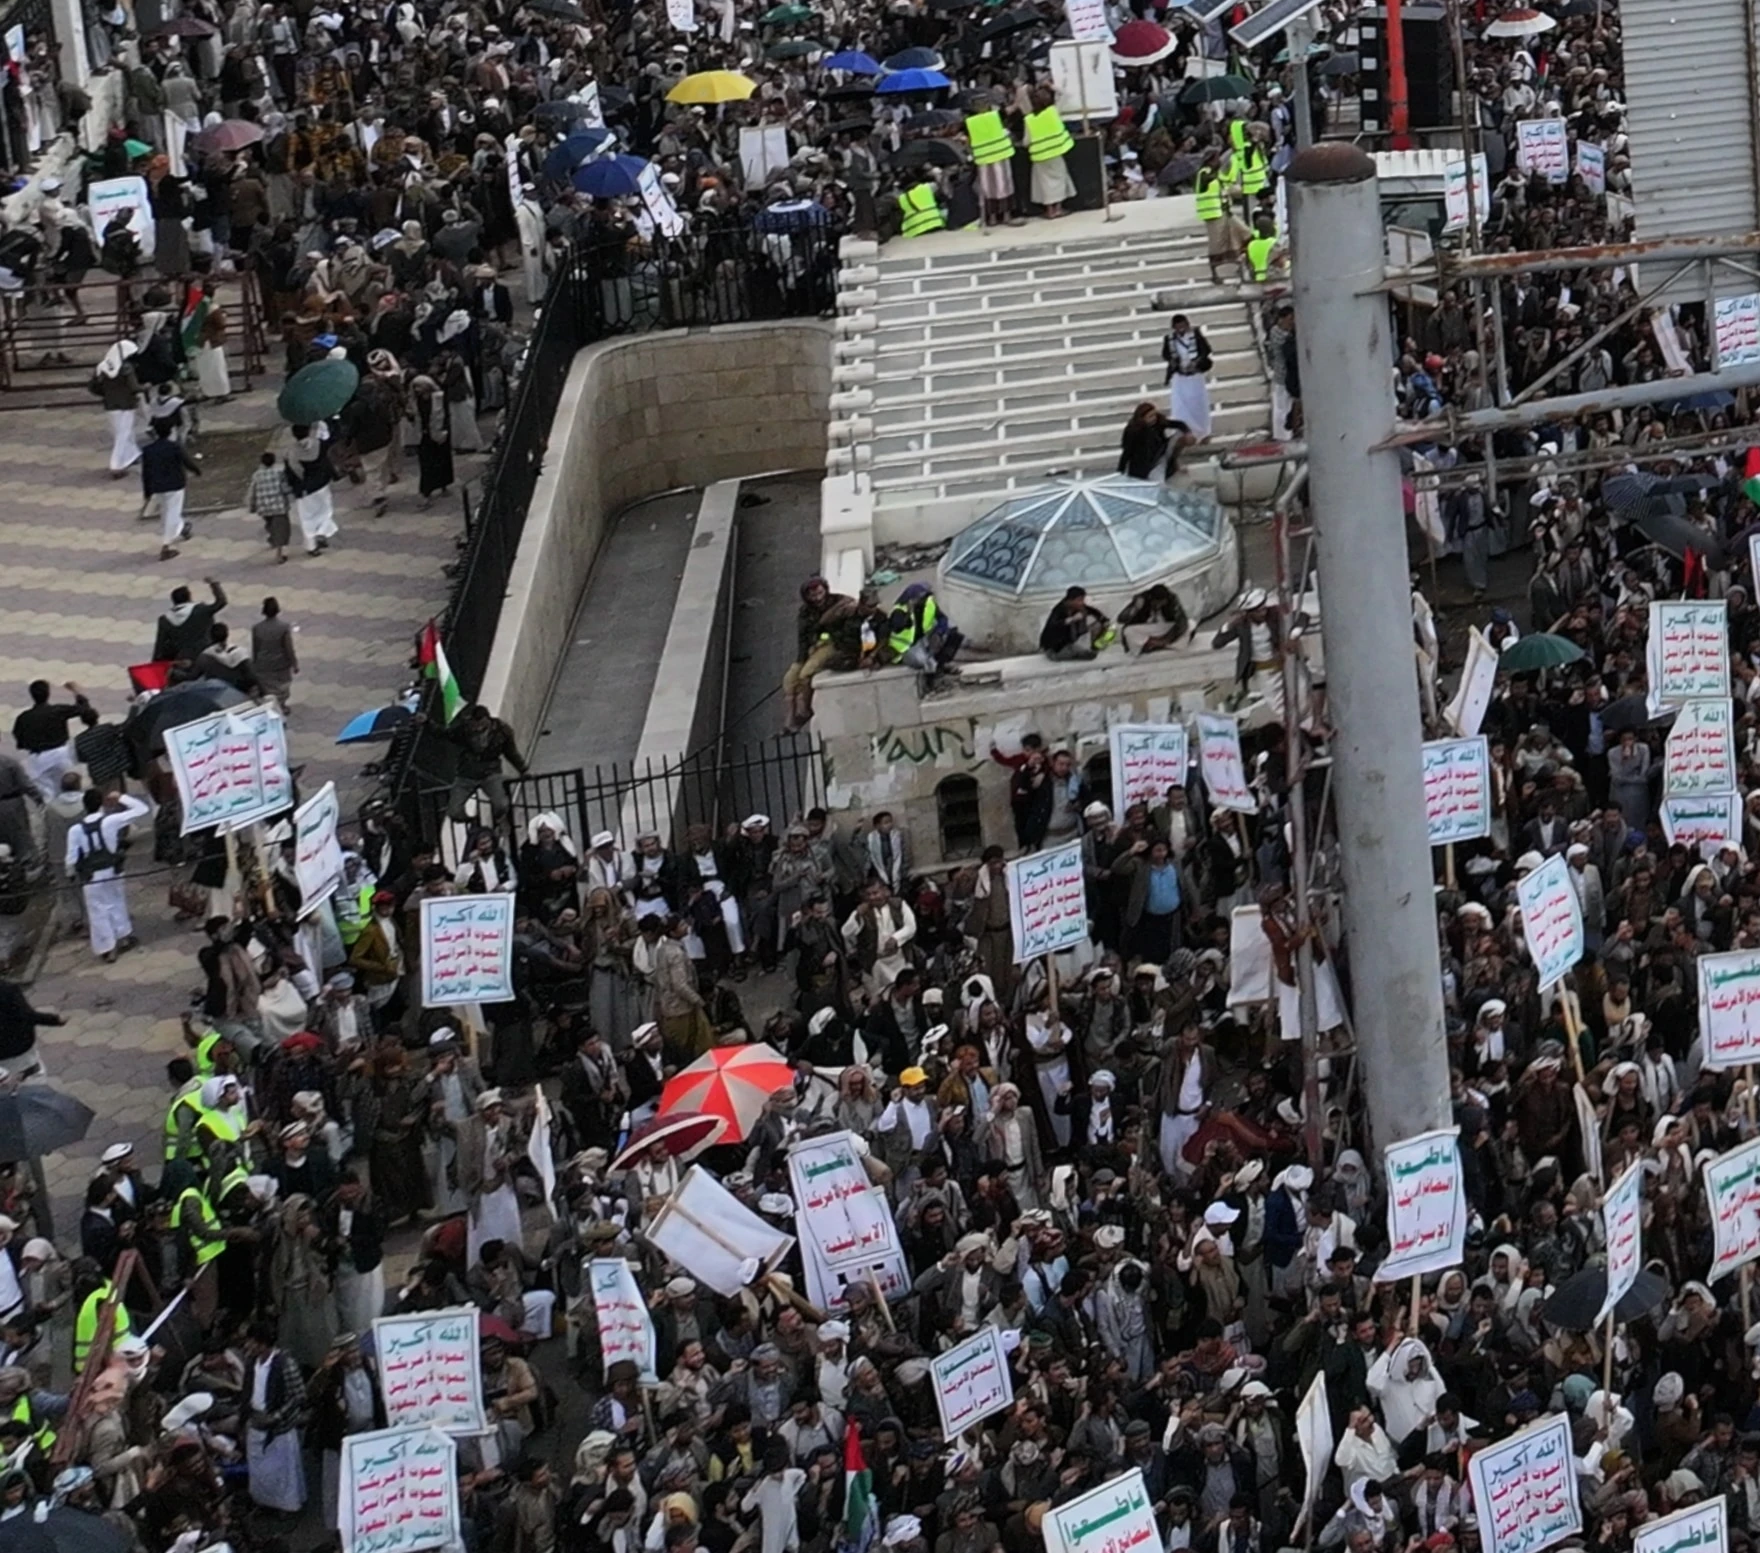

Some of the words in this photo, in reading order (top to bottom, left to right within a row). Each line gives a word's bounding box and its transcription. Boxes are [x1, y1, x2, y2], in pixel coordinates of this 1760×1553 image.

[478, 908, 497, 922] الله
[476, 929, 500, 941] الموت
[475, 948, 500, 959] الموت
[940, 1342, 992, 1379] قاطعوا
[1536, 1433, 1562, 1459] الله
[1532, 1456, 1564, 1481] الموت
[1534, 1477, 1566, 1499] الموت
